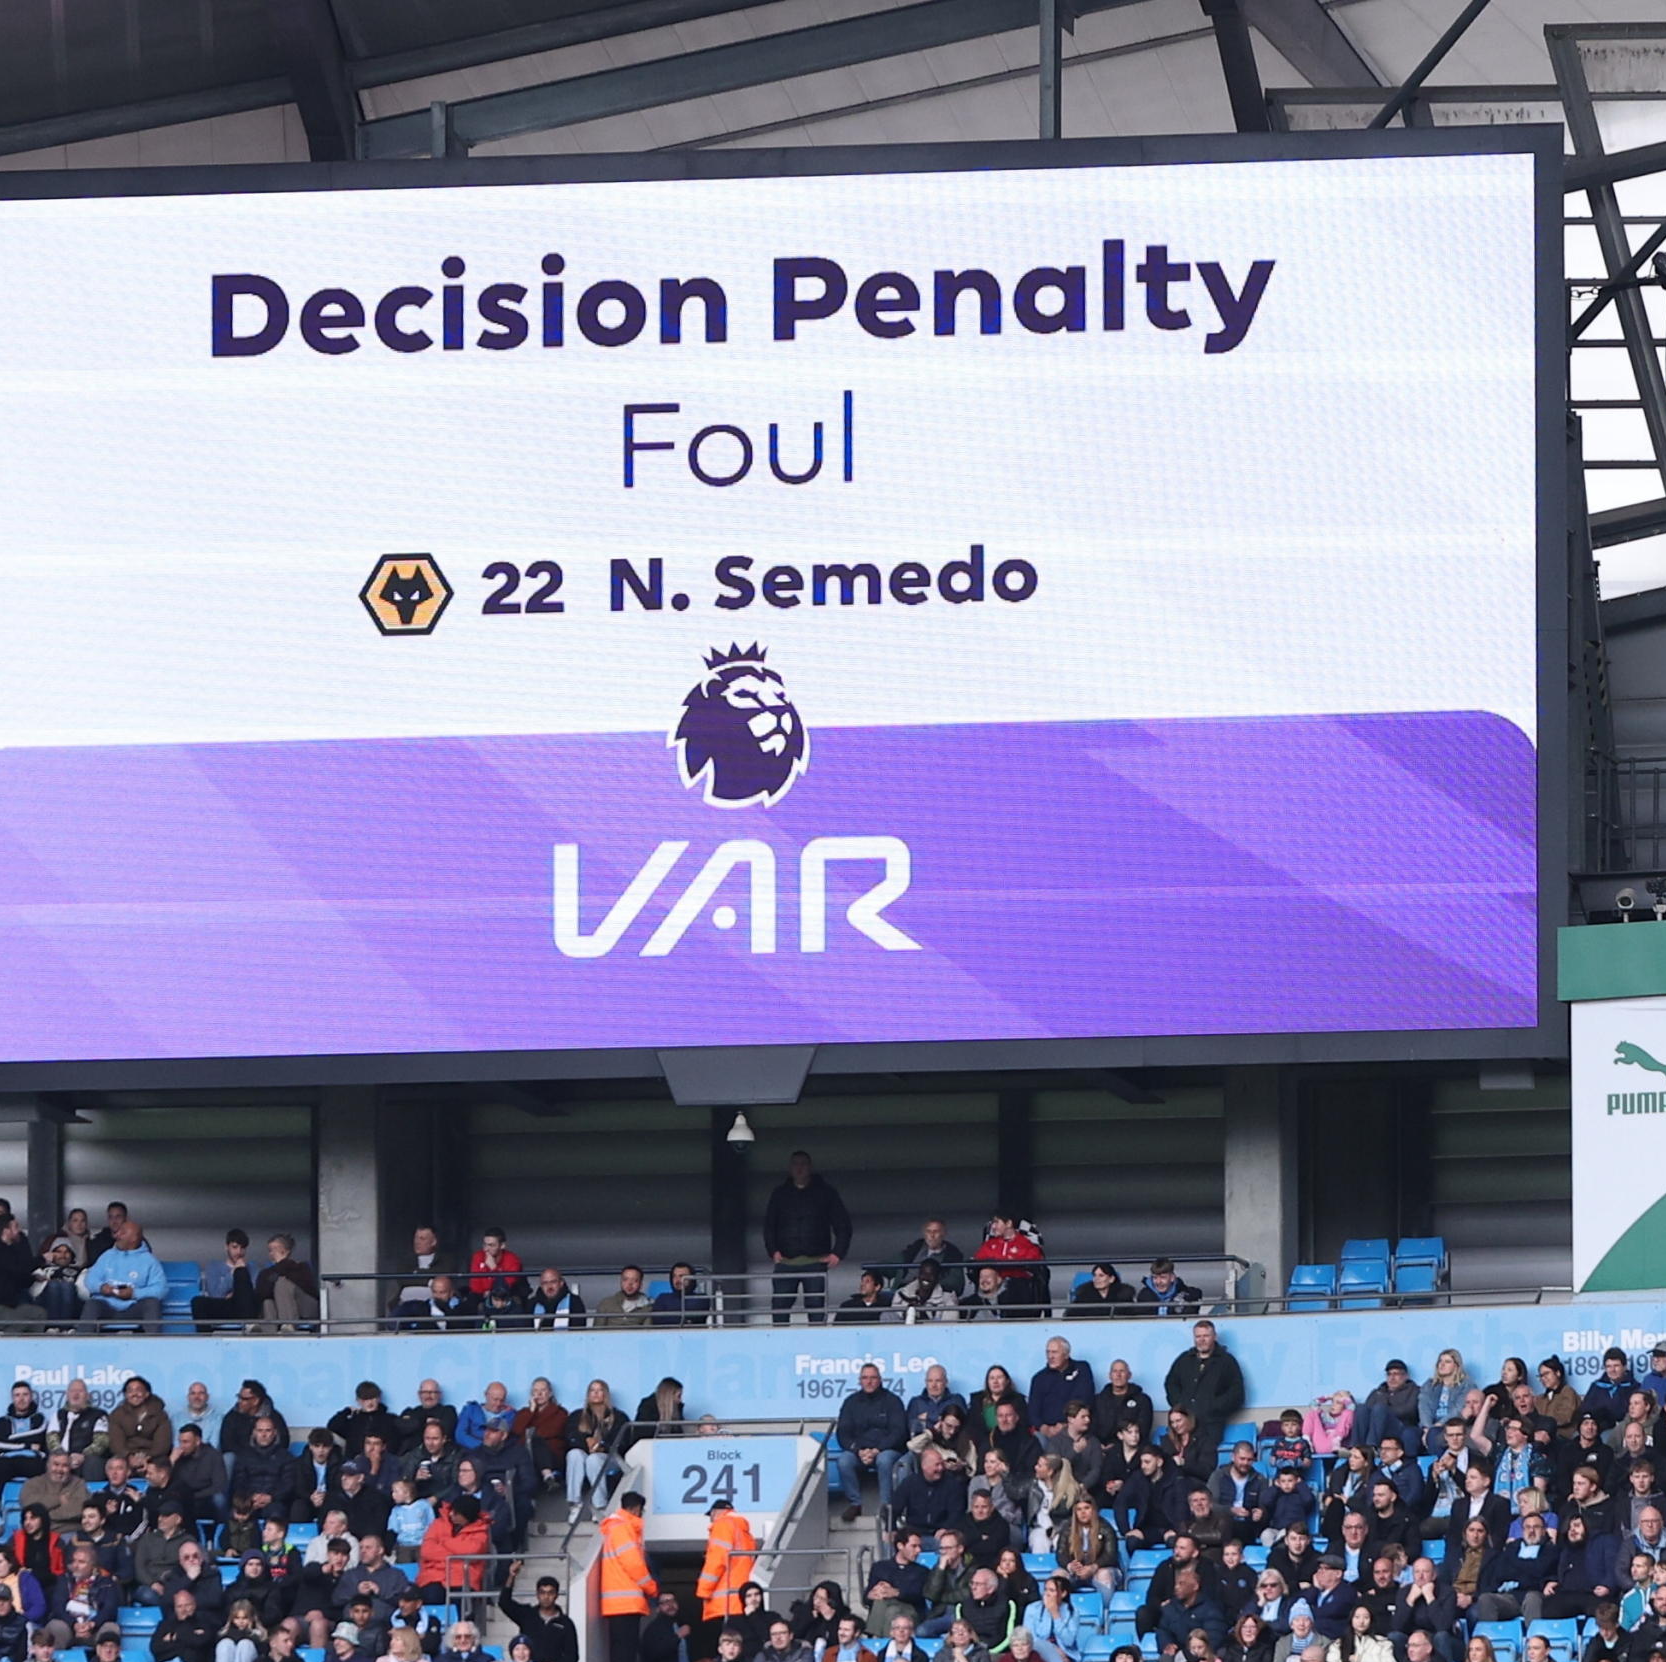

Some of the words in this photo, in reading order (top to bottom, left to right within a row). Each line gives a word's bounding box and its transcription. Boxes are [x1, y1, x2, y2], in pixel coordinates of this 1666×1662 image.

[212, 253, 727, 357] Decision
[774, 239, 1275, 354] Penalty
[624, 390, 852, 488] Foul
[482, 560, 564, 614] 22
[611, 558, 690, 612] N.
[715, 545, 1037, 611] Semedo
[555, 836, 921, 957] VAR
[1563, 1331, 1613, 1355] Billy
[15, 1365, 69, 1385] Paul
[77, 1364, 136, 1385] Lake
[796, 1354, 887, 1375] Francis
[895, 1353, 939, 1374] Lee
[707, 1449, 742, 1461] Block
[682, 1463, 761, 1503] 241
